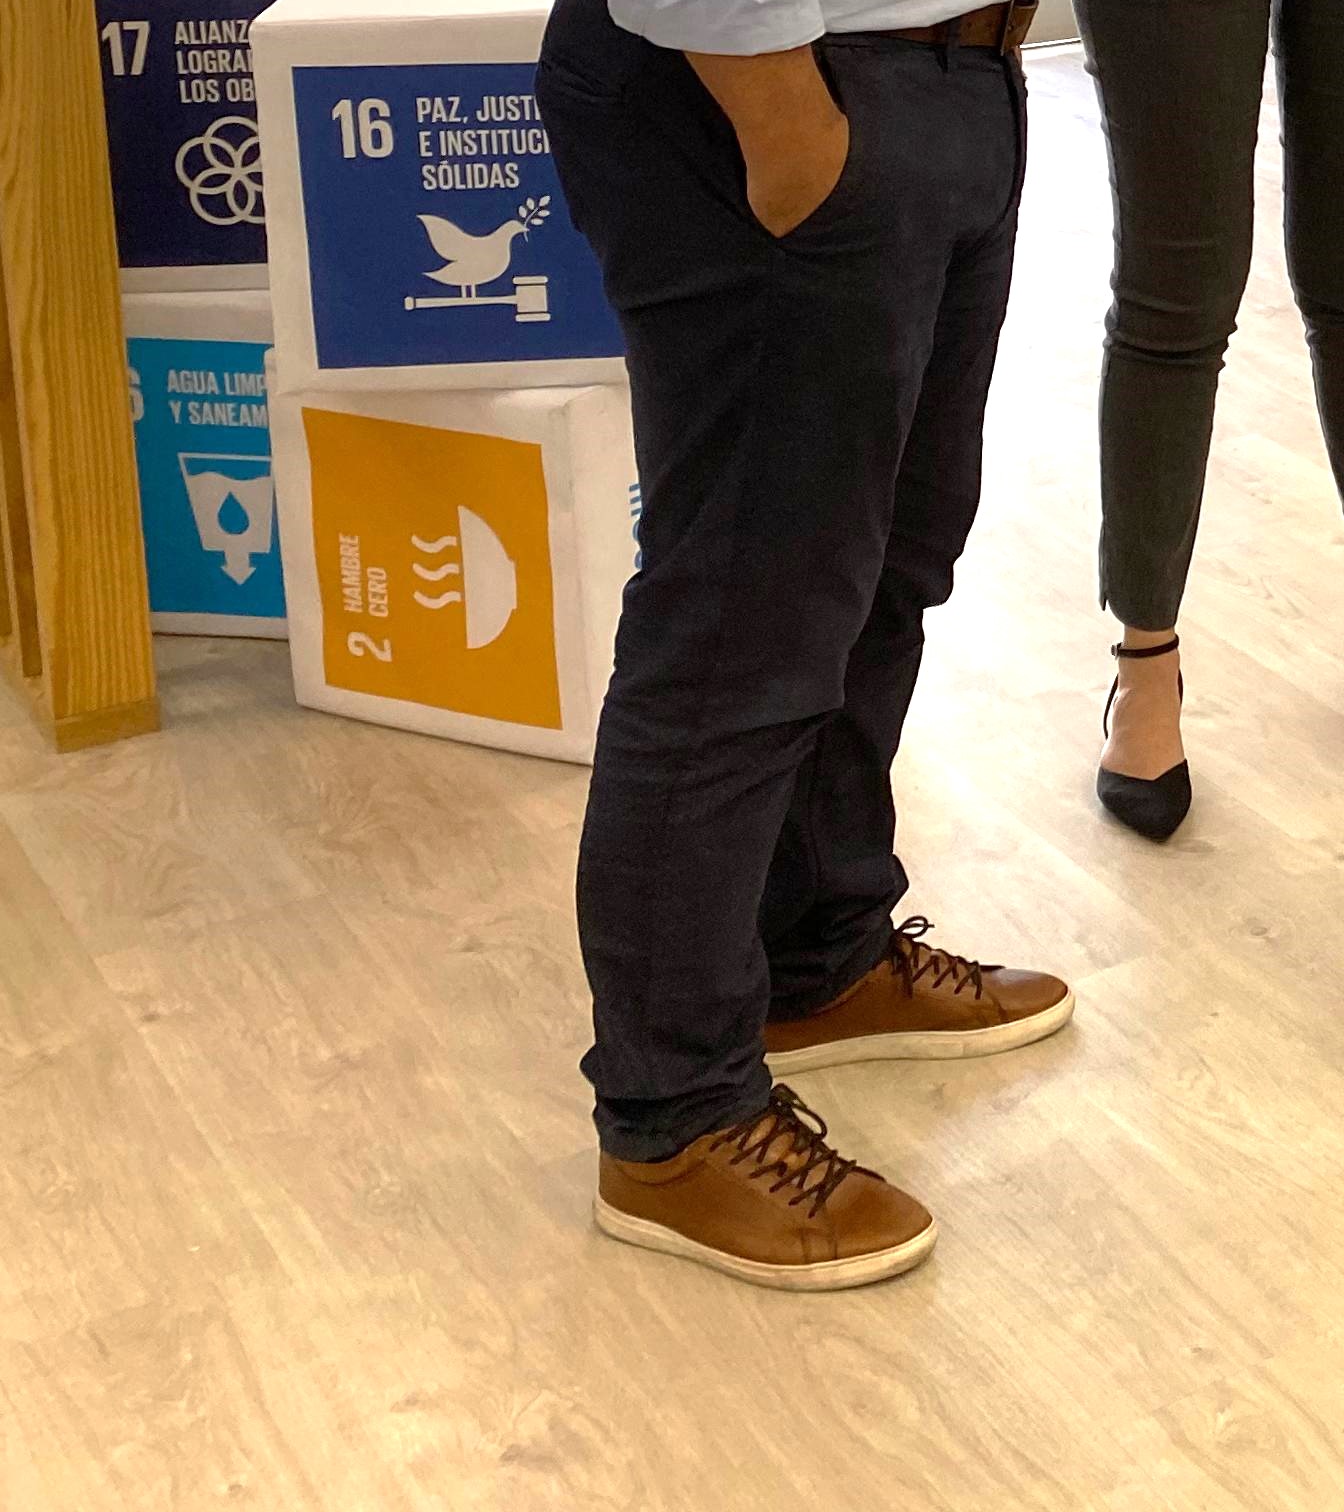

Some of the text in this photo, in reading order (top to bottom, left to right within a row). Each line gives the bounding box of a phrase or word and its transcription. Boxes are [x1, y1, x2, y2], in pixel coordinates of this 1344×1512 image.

[101, 20, 151, 76] 17
[179, 78, 220, 103] LOS
[416, 96, 469, 124] PAZ,
[331, 98, 394, 159] 16
[419, 131, 433, 157] E
[422, 160, 520, 191] SÓLIDAS
[167, 369, 219, 395] AGUA
[168, 400, 182, 424] Y
[339, 532, 363, 613] HAMBRE
[367, 566, 389, 617] CERO
[347, 631, 392, 663] 2
